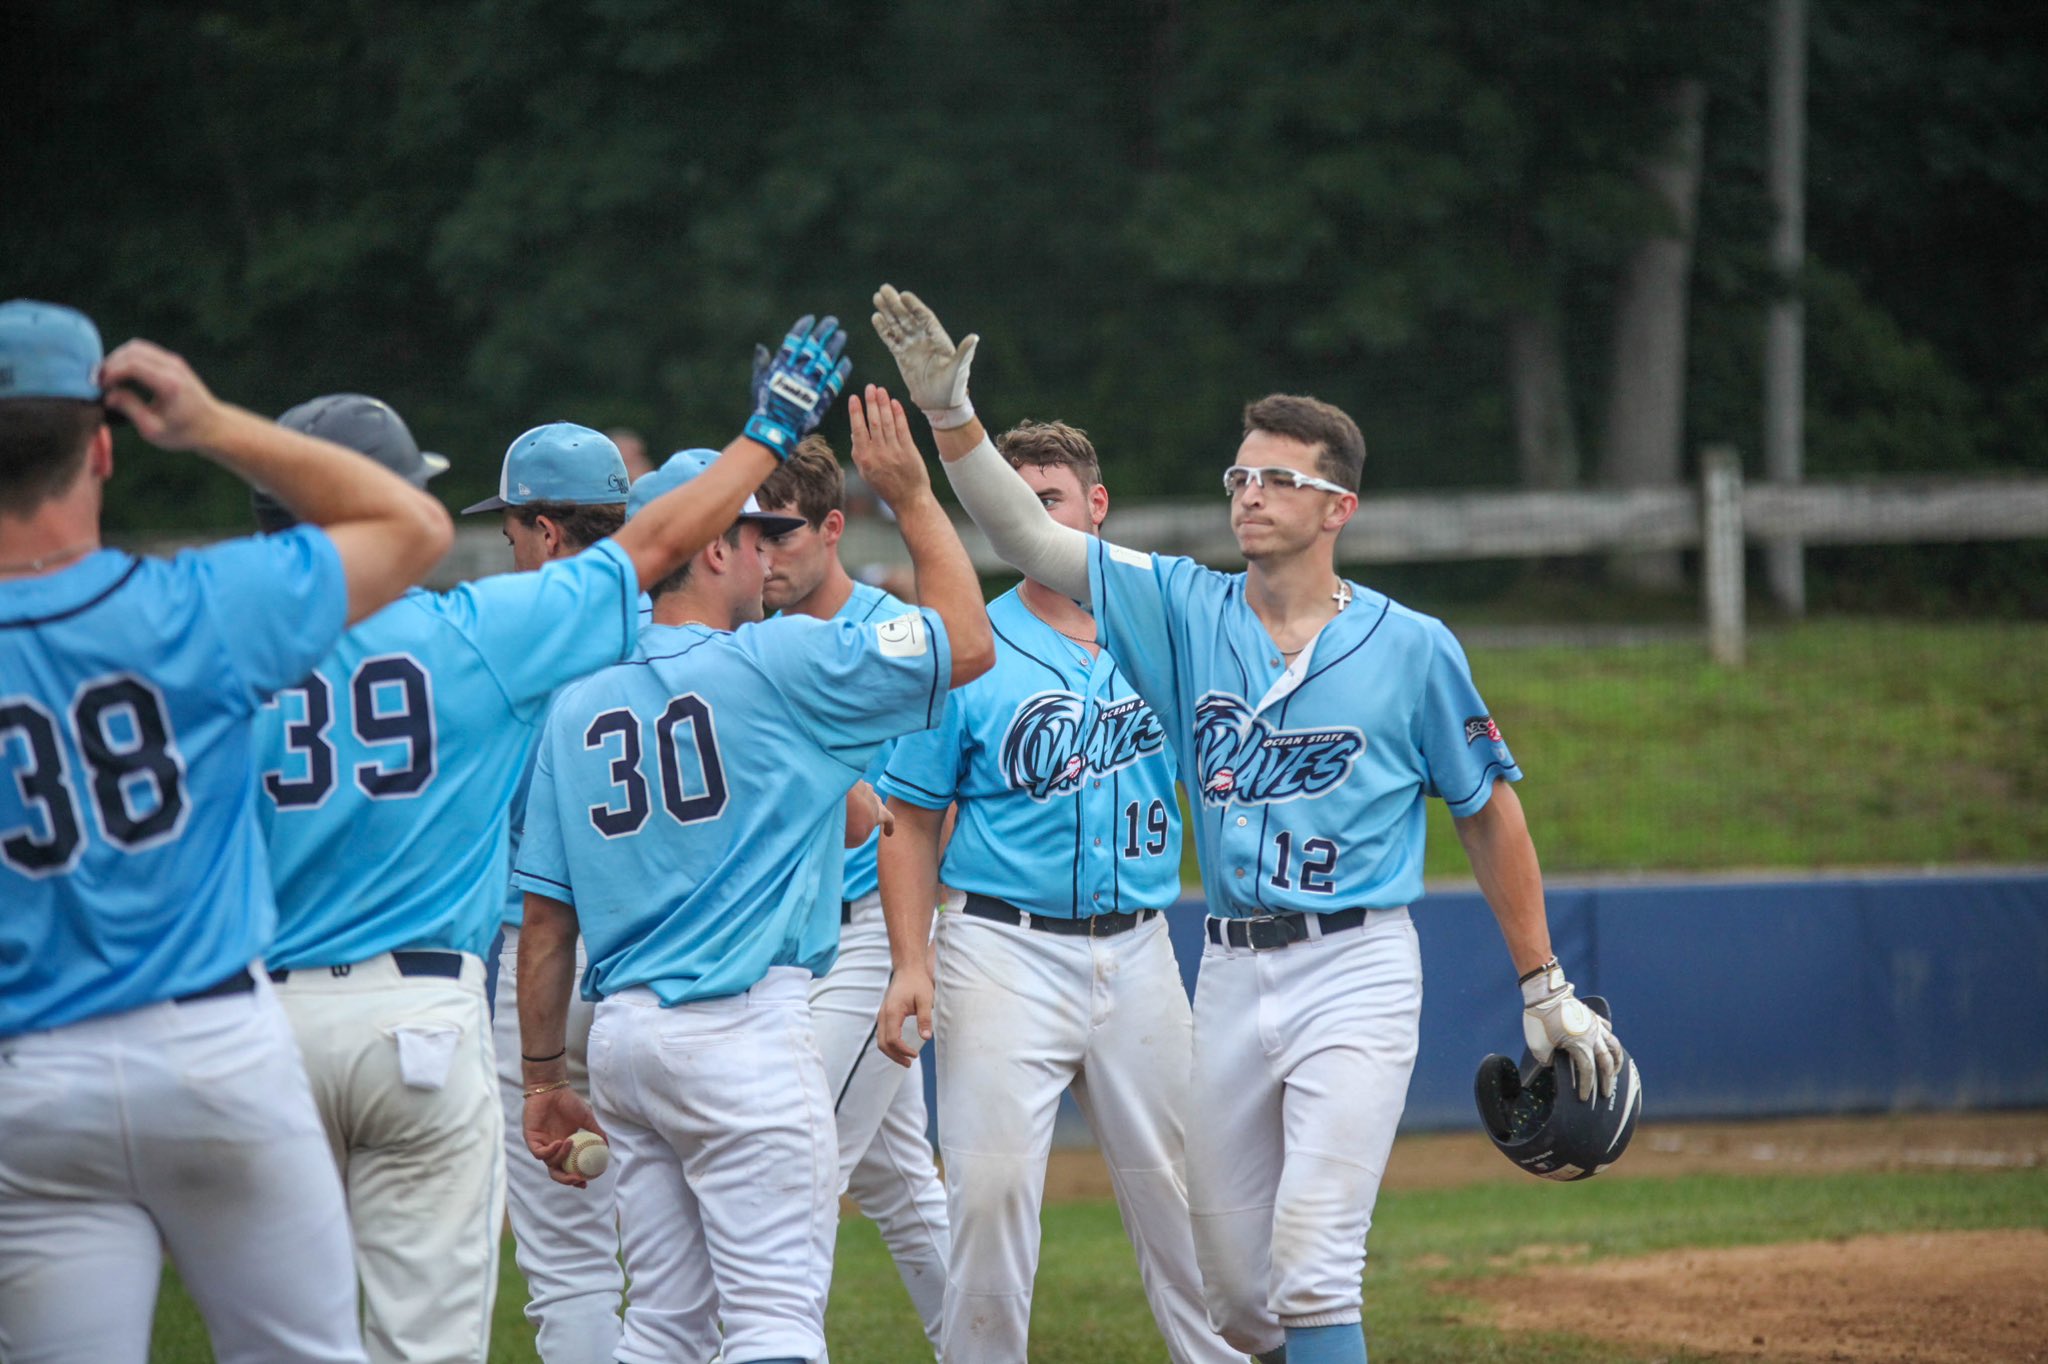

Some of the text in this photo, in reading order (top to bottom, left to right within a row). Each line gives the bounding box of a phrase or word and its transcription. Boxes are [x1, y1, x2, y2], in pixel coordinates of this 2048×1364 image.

[262, 651, 438, 813] 39
[1101, 701, 1136, 721] OCEAN
[1262, 732, 1346, 748] OCEAN STATE
[0, 672, 193, 880] 38
[583, 690, 730, 840] 30
[1196, 720, 1361, 801] WAVES
[1123, 798, 1169, 860] 19
[1270, 830, 1341, 895] 12
